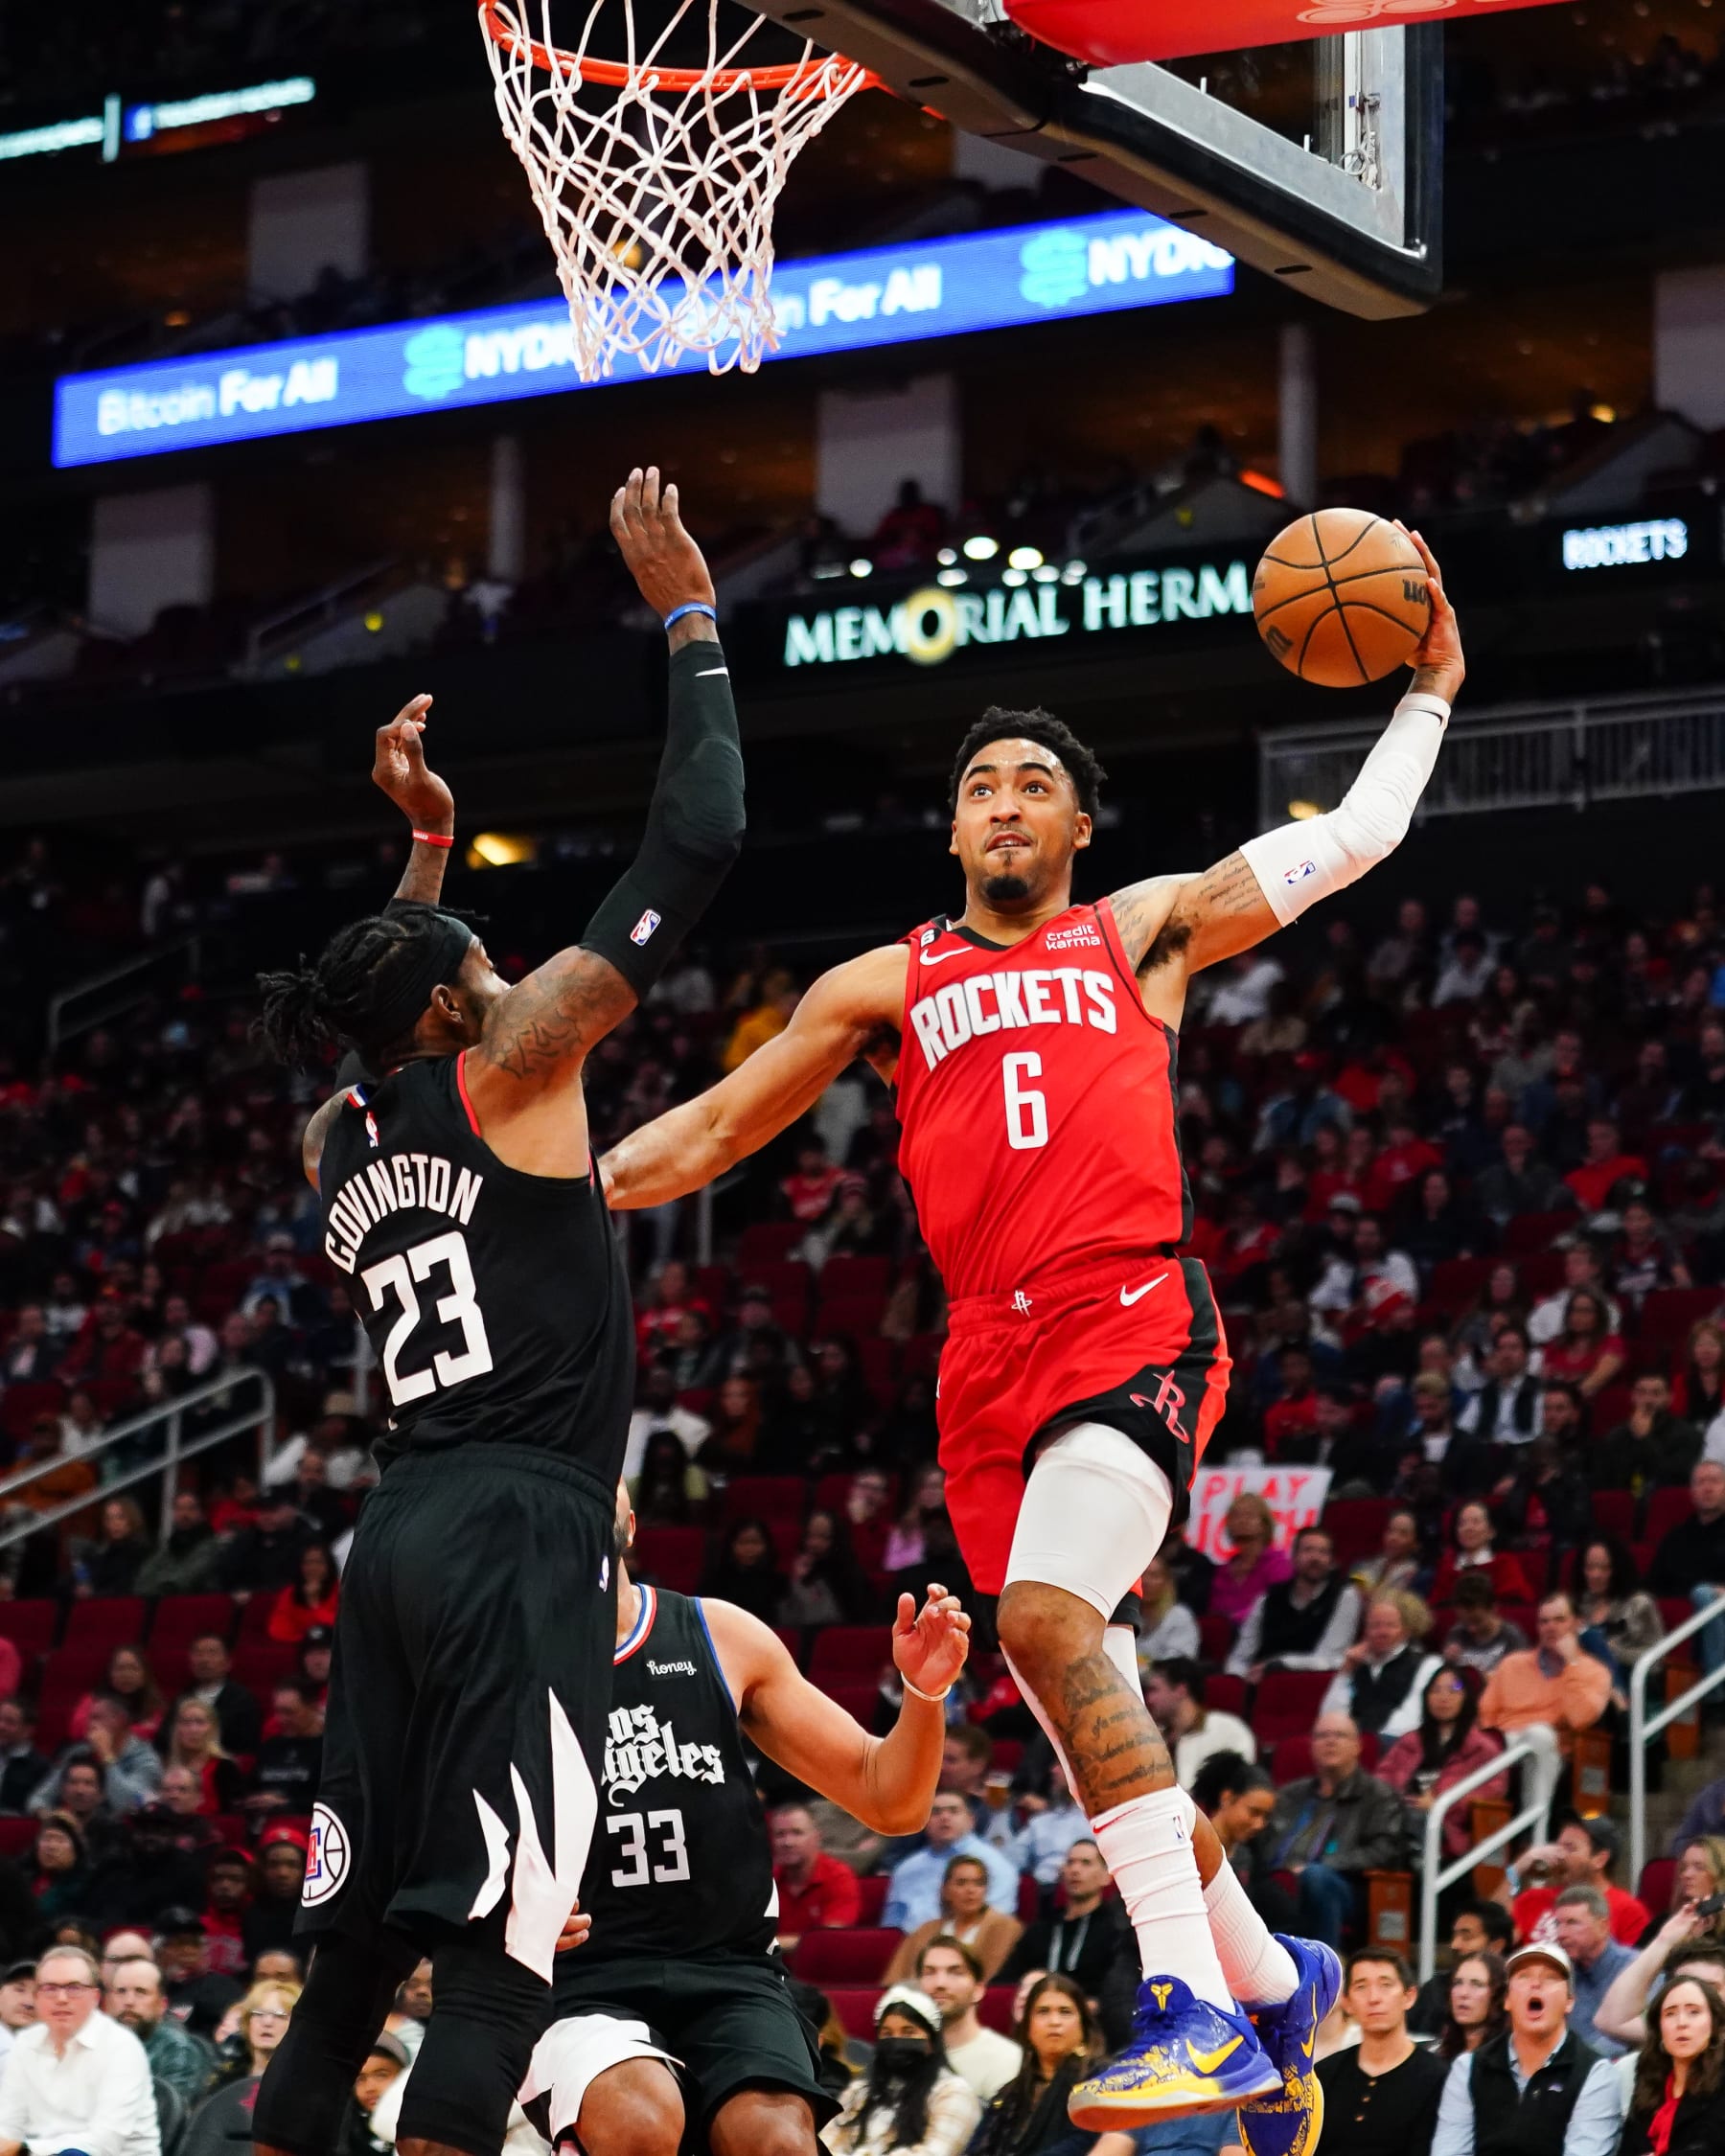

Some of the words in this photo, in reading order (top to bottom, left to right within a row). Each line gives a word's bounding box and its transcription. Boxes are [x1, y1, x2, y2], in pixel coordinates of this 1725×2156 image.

[810, 278, 879, 325] For
[882, 264, 942, 315] All
[97, 385, 217, 435] Bitcoin
[219, 368, 282, 416] For
[283, 356, 338, 406] All
[784, 583, 1070, 666] MEMORIAL
[1083, 561, 1254, 631] HERM
[1046, 924, 1094, 941] credit
[1046, 935, 1101, 952] karma
[909, 968, 1117, 1073] ROCKETS
[1002, 1051, 1048, 1150] 6
[324, 1153, 484, 1274] COVINGTON
[360, 1230, 494, 1407] 23
[646, 1660, 698, 1677] honey
[608, 1703, 661, 1746] os
[606, 1808, 691, 1888] 33
